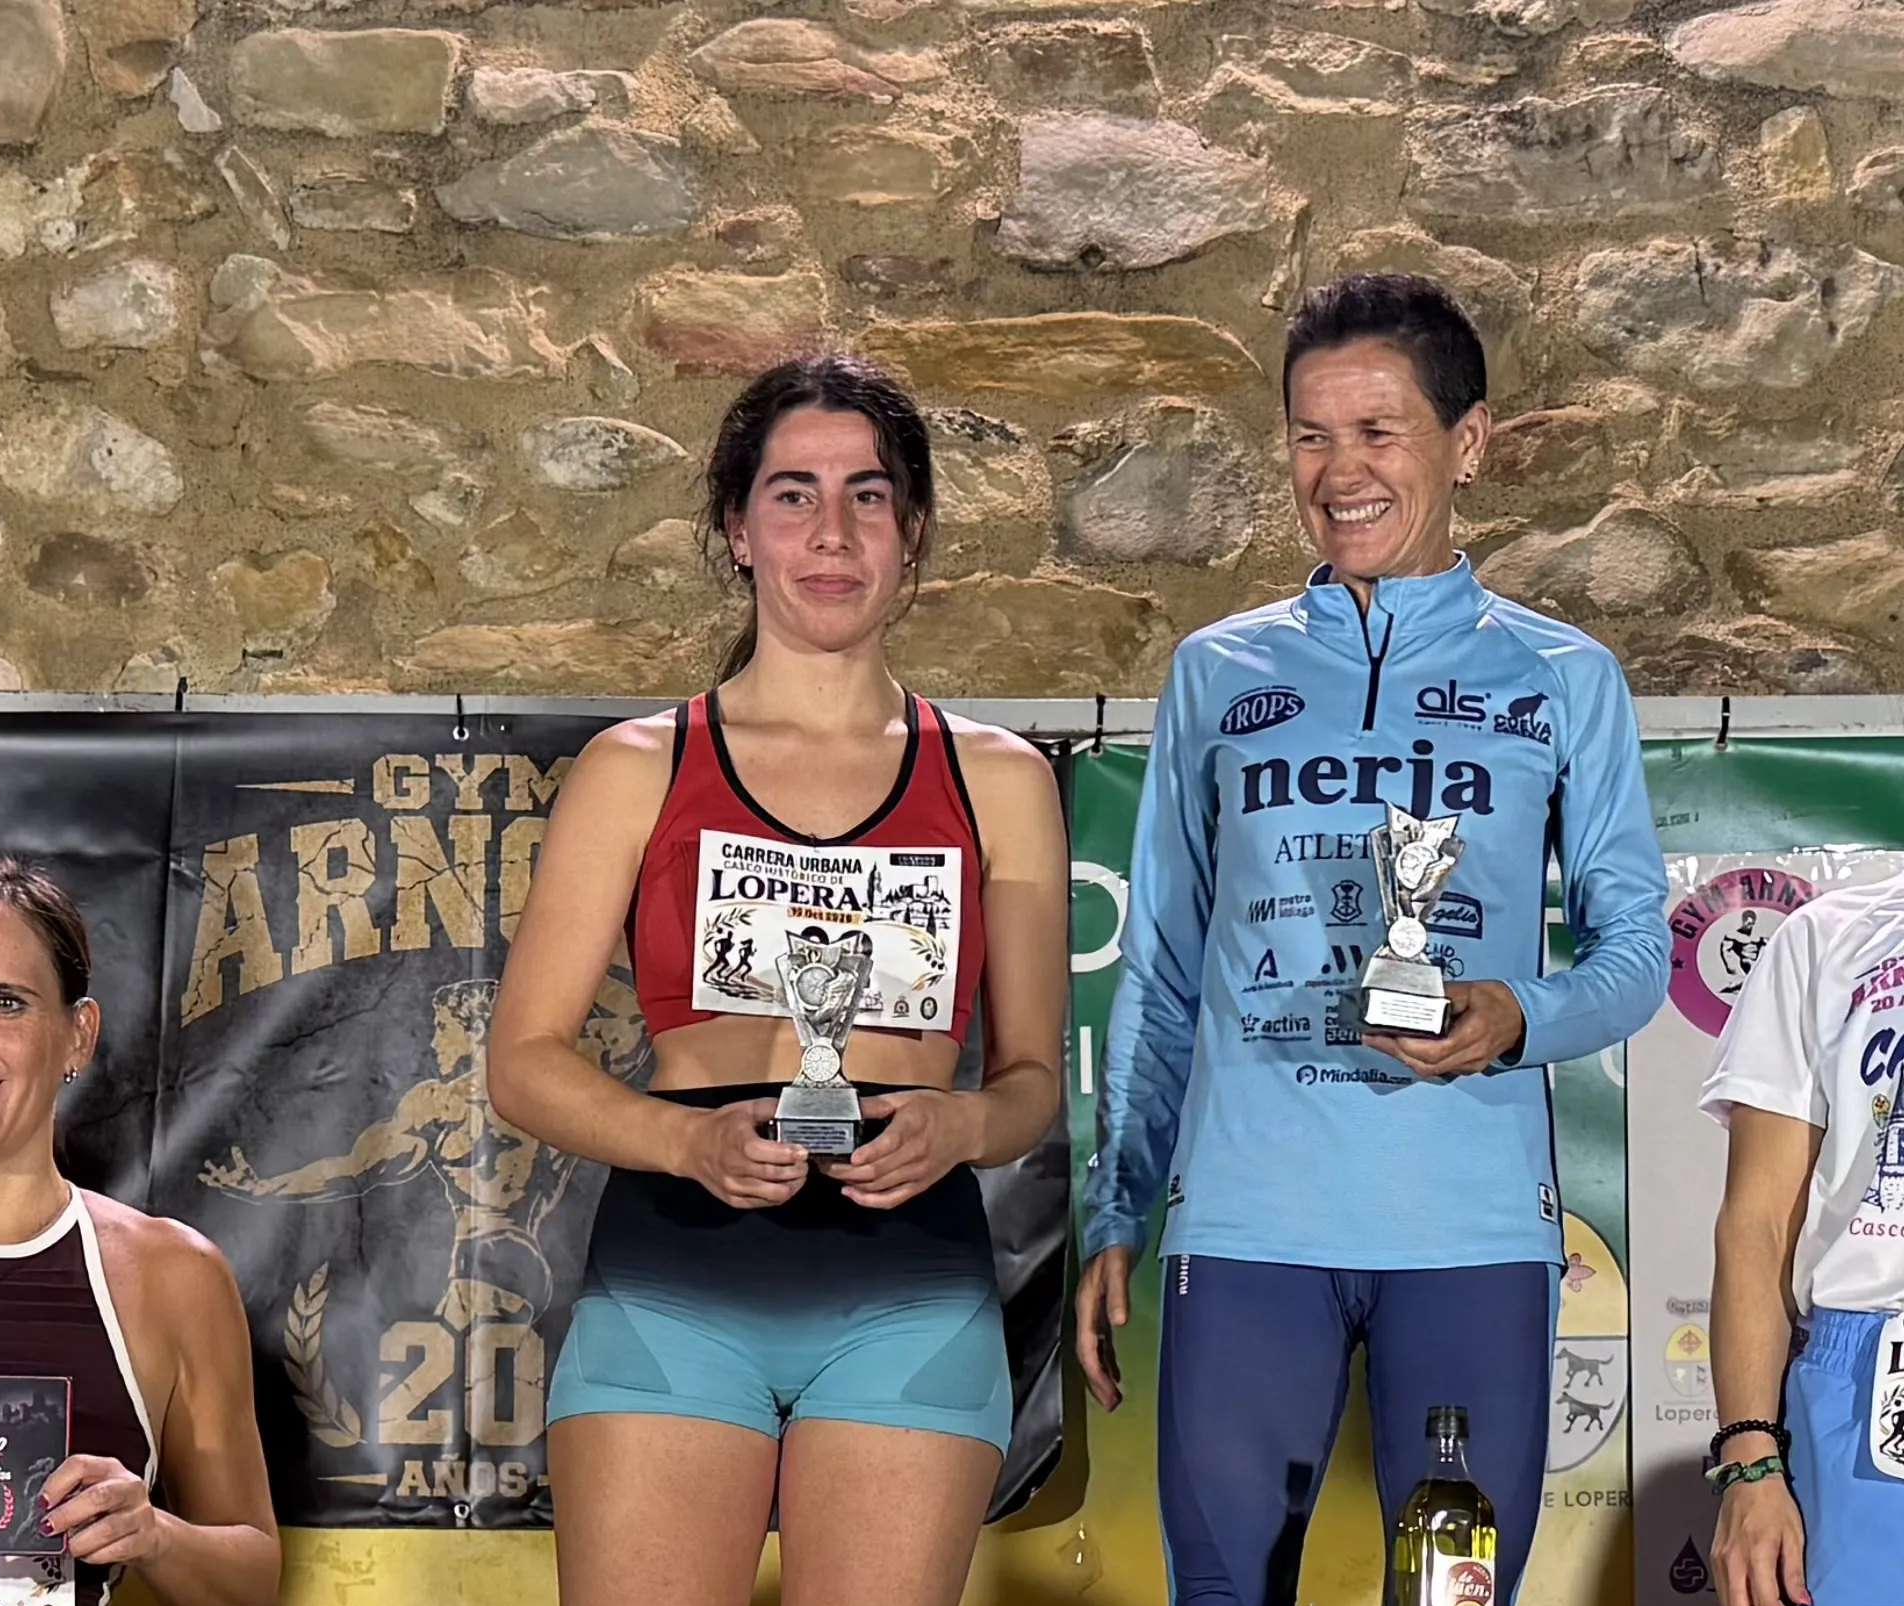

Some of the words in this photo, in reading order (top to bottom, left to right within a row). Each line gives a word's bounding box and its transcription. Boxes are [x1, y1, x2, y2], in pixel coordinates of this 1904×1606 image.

[1222, 693, 1303, 733] TROPS
[373, 754, 575, 810] GYM
[1241, 739, 1494, 822] nerja
[722, 843, 794, 869] CARRERA
[799, 857, 863, 875] URBANA
[1274, 833, 1372, 865] ATLET
[708, 868, 864, 912] LOPERA
[181, 815, 549, 1028] ARN
[378, 1321, 545, 1446] 20
[396, 1453, 528, 1498] AÑOS
[1564, 1491, 1633, 1507] LOPER
